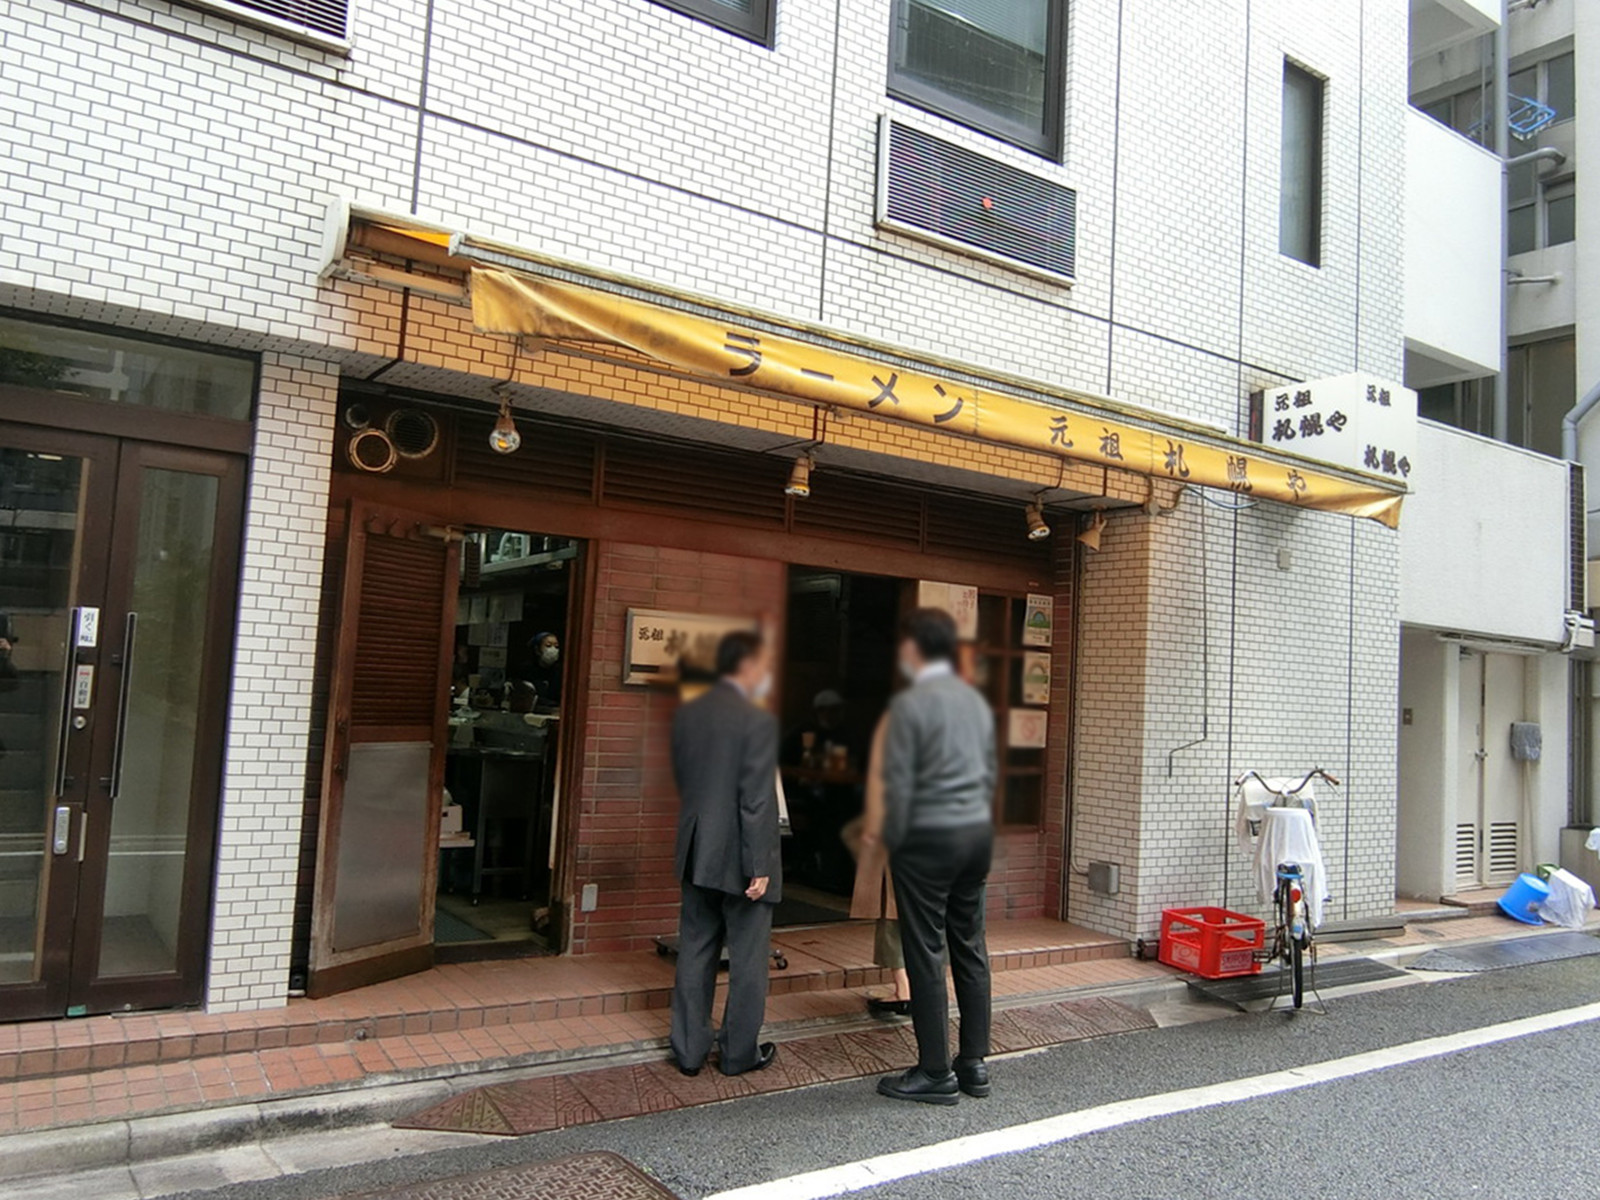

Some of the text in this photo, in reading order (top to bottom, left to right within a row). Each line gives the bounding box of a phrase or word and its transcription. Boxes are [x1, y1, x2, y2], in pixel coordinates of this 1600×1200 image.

[724, 332, 963, 423] ラーメン
[1274, 389, 1313, 412] 元祖
[1366, 384, 1391, 407] 元祖
[1271, 410, 1348, 442] 札幌や
[1364, 444, 1411, 478] 札幌や
[84, 612, 95, 631] 引く
[638, 626, 664, 641] 元祖
